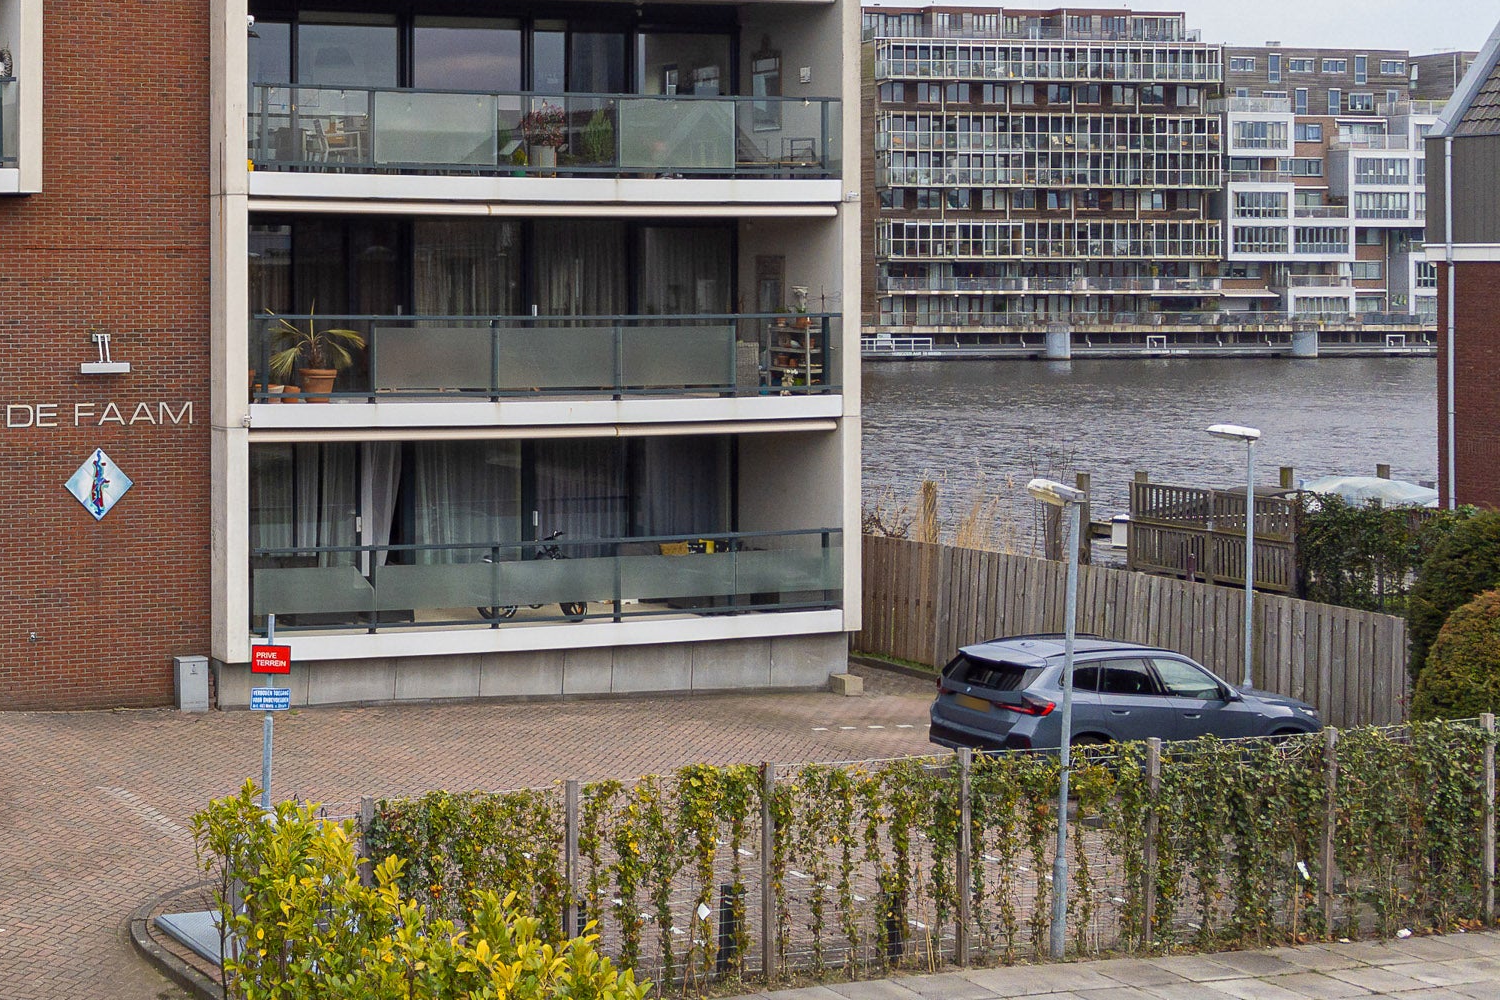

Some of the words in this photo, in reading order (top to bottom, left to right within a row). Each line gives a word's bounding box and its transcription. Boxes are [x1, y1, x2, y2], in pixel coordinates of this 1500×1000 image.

[6, 403, 58, 428] DE
[74, 401, 193, 427] FAAM
[256, 659, 287, 667] TERREIN
